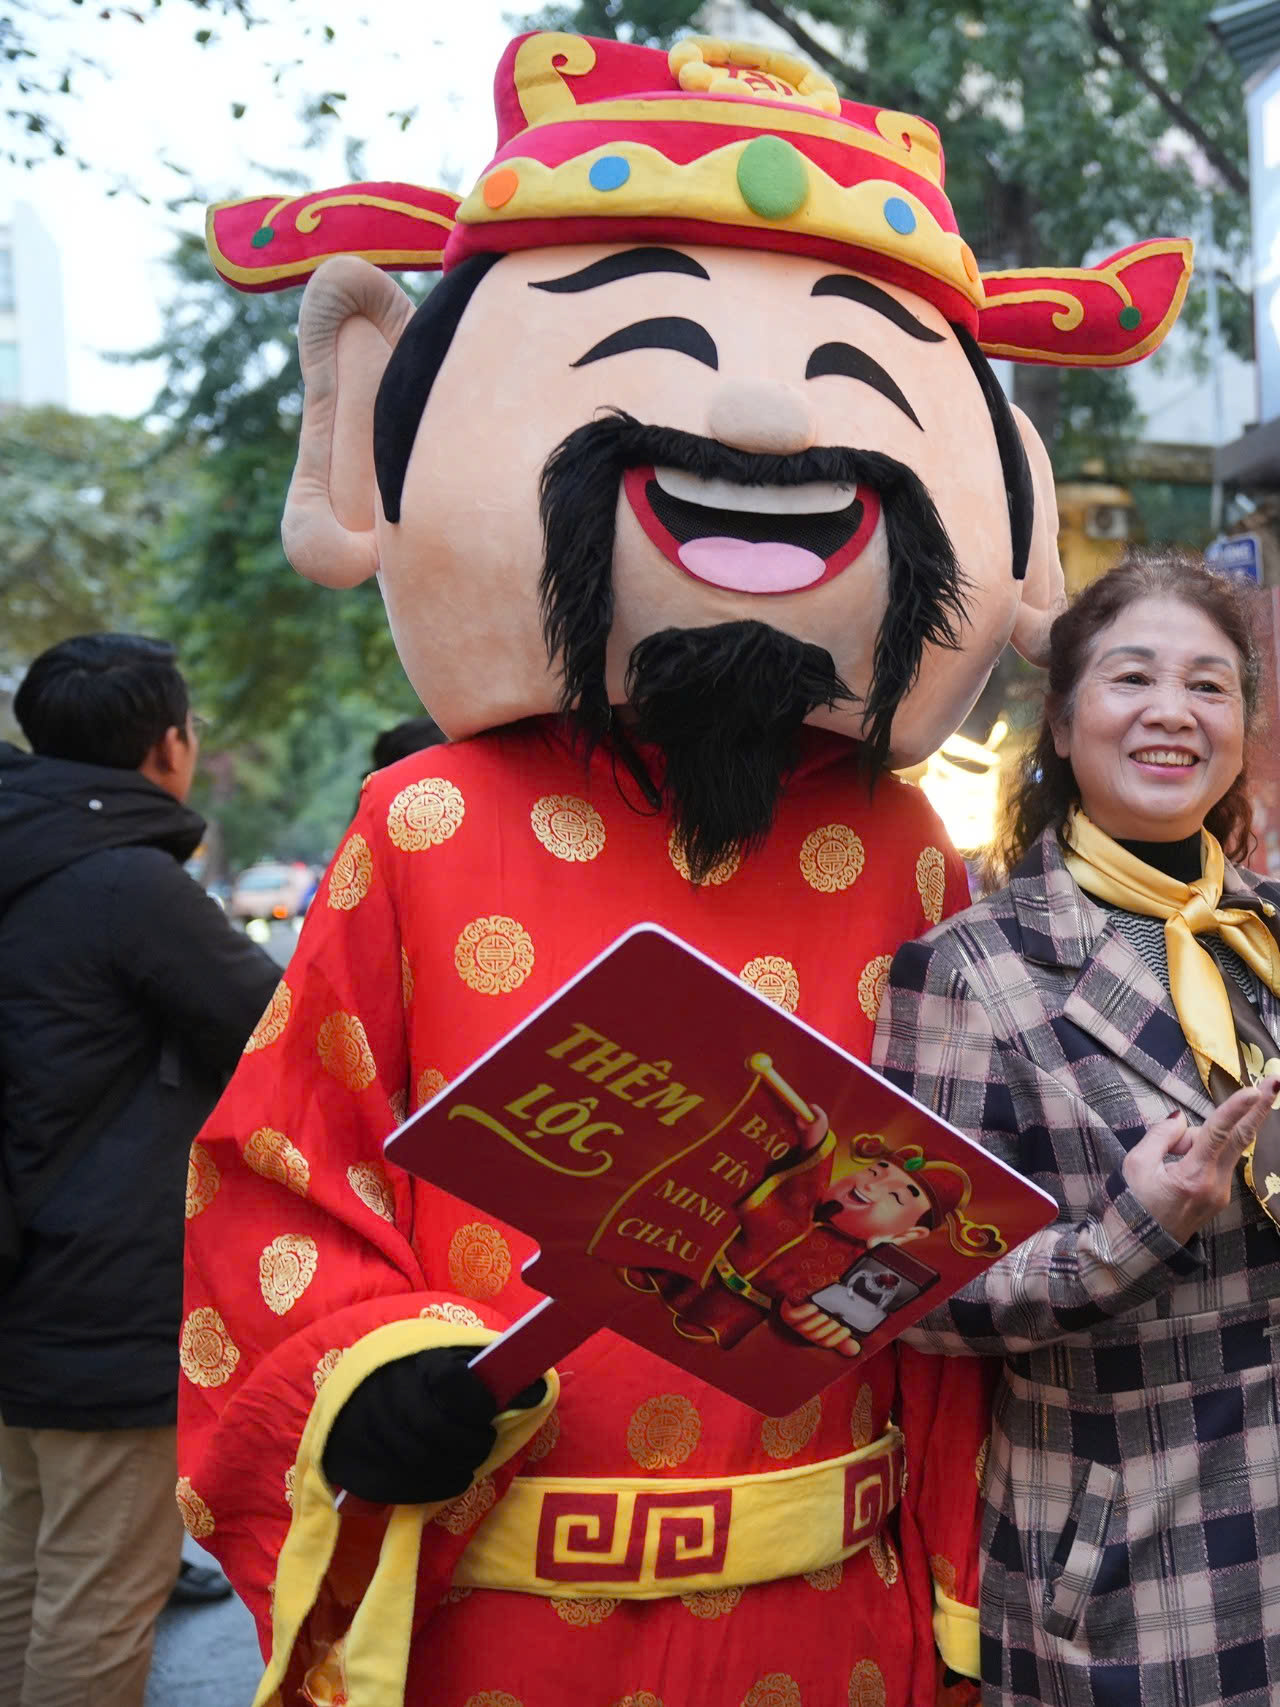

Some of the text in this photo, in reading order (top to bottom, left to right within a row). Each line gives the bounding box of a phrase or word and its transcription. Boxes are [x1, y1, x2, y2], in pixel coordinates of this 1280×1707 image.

[545, 1022, 705, 1126] THÊM
[503, 1083, 625, 1154] LỘC
[709, 1152, 750, 1189] TÍN
[653, 1179, 727, 1227] MINH
[617, 1217, 701, 1262] CHÂU
